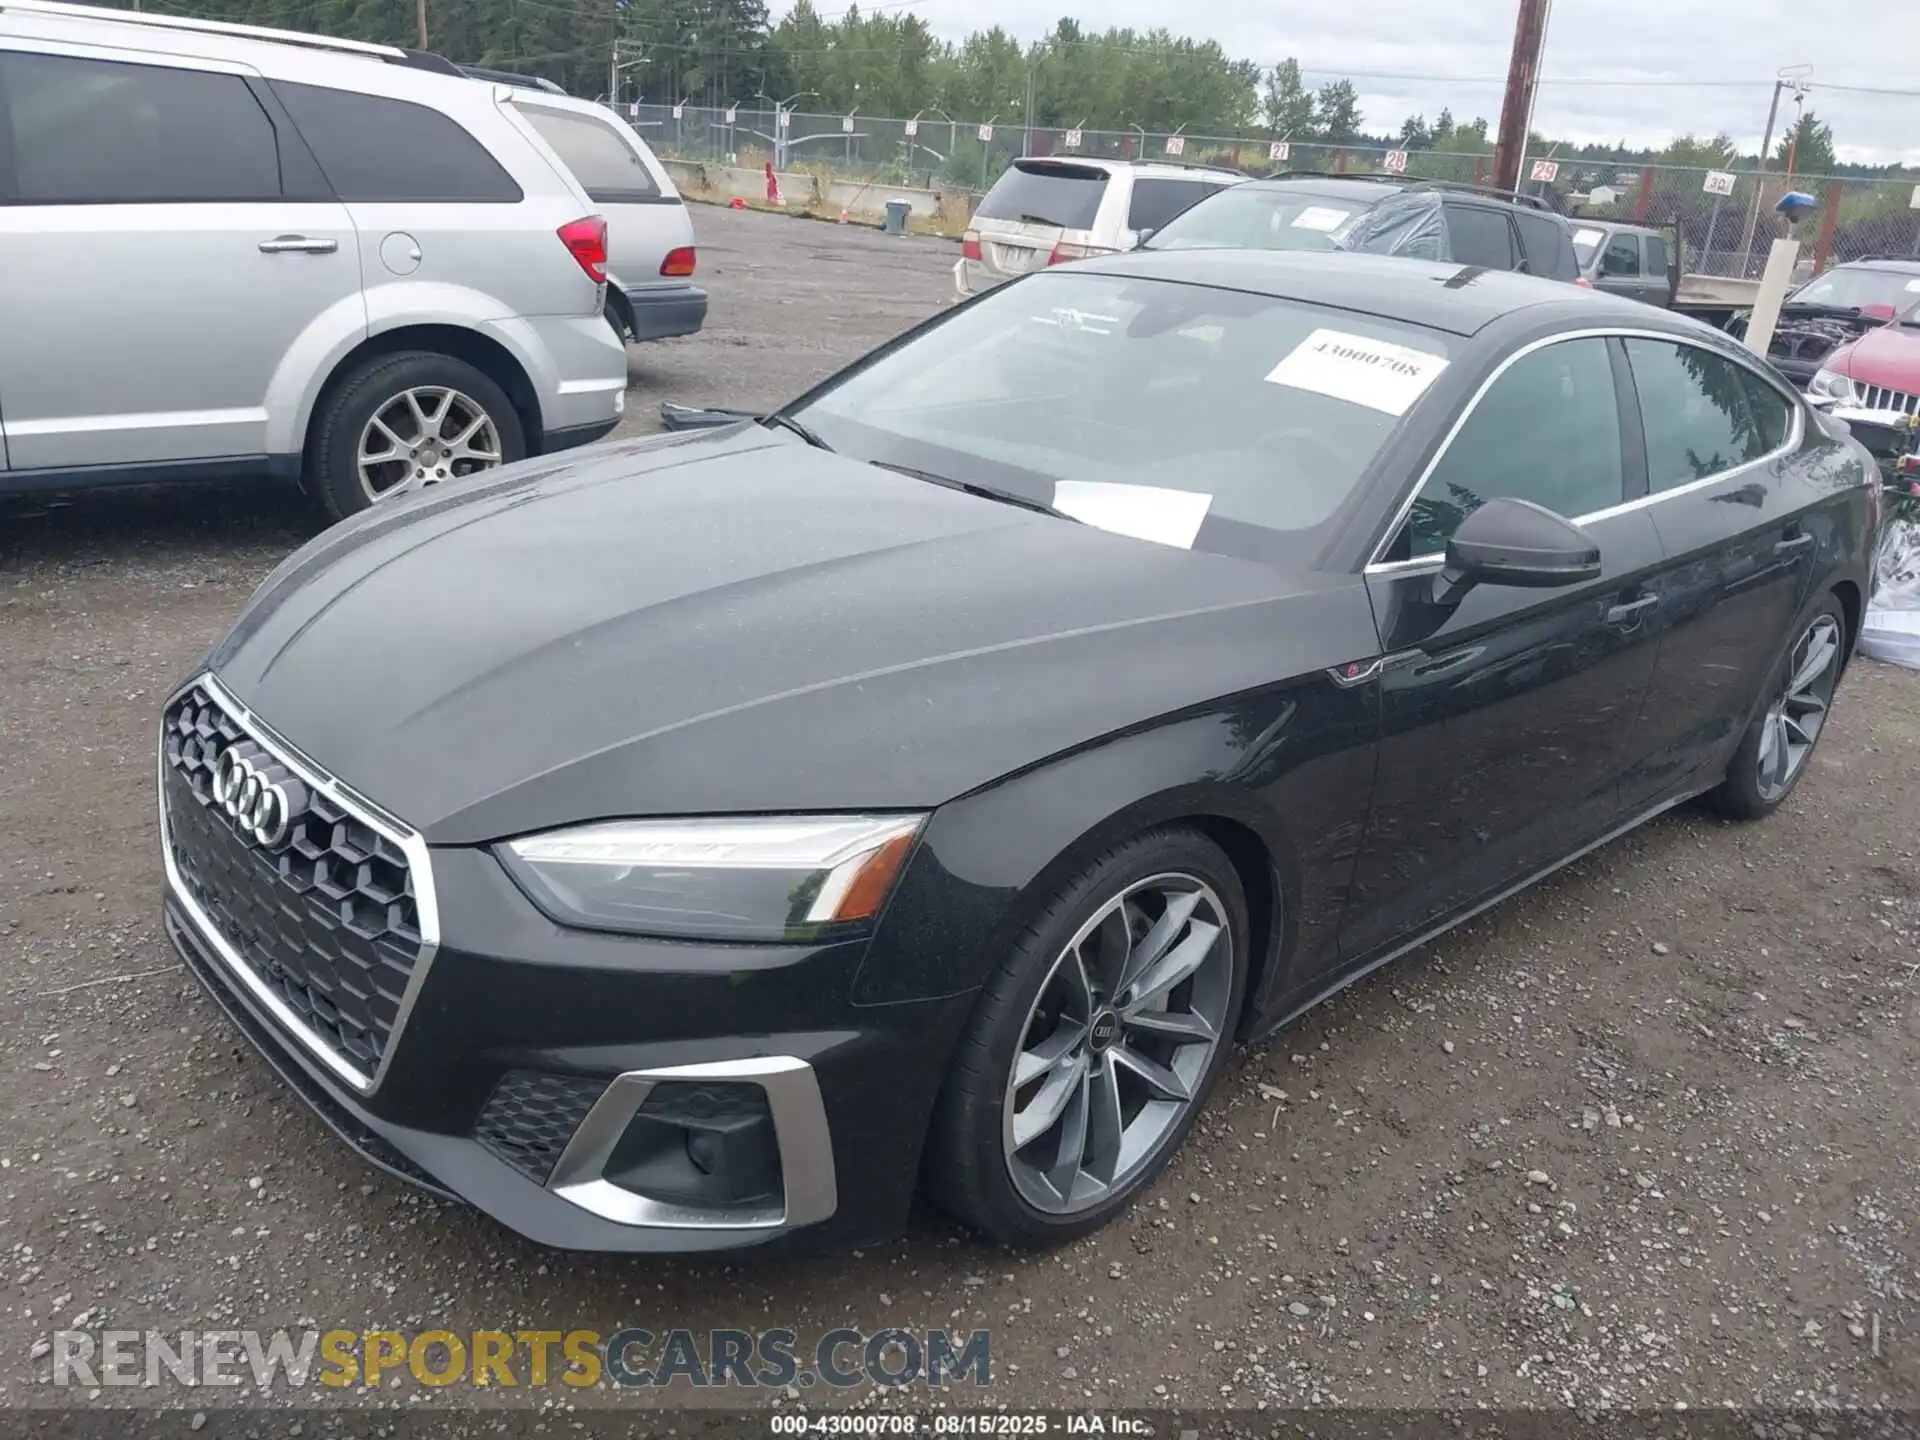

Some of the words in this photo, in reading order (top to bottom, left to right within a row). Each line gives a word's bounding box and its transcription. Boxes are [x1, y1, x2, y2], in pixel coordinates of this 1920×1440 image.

[1273, 144, 1287, 158] 27
[1387, 152, 1405, 170] 28
[1534, 162, 1555, 180] 29
[1710, 178, 1726, 190] 30
[1313, 342, 1421, 377] 43000708
